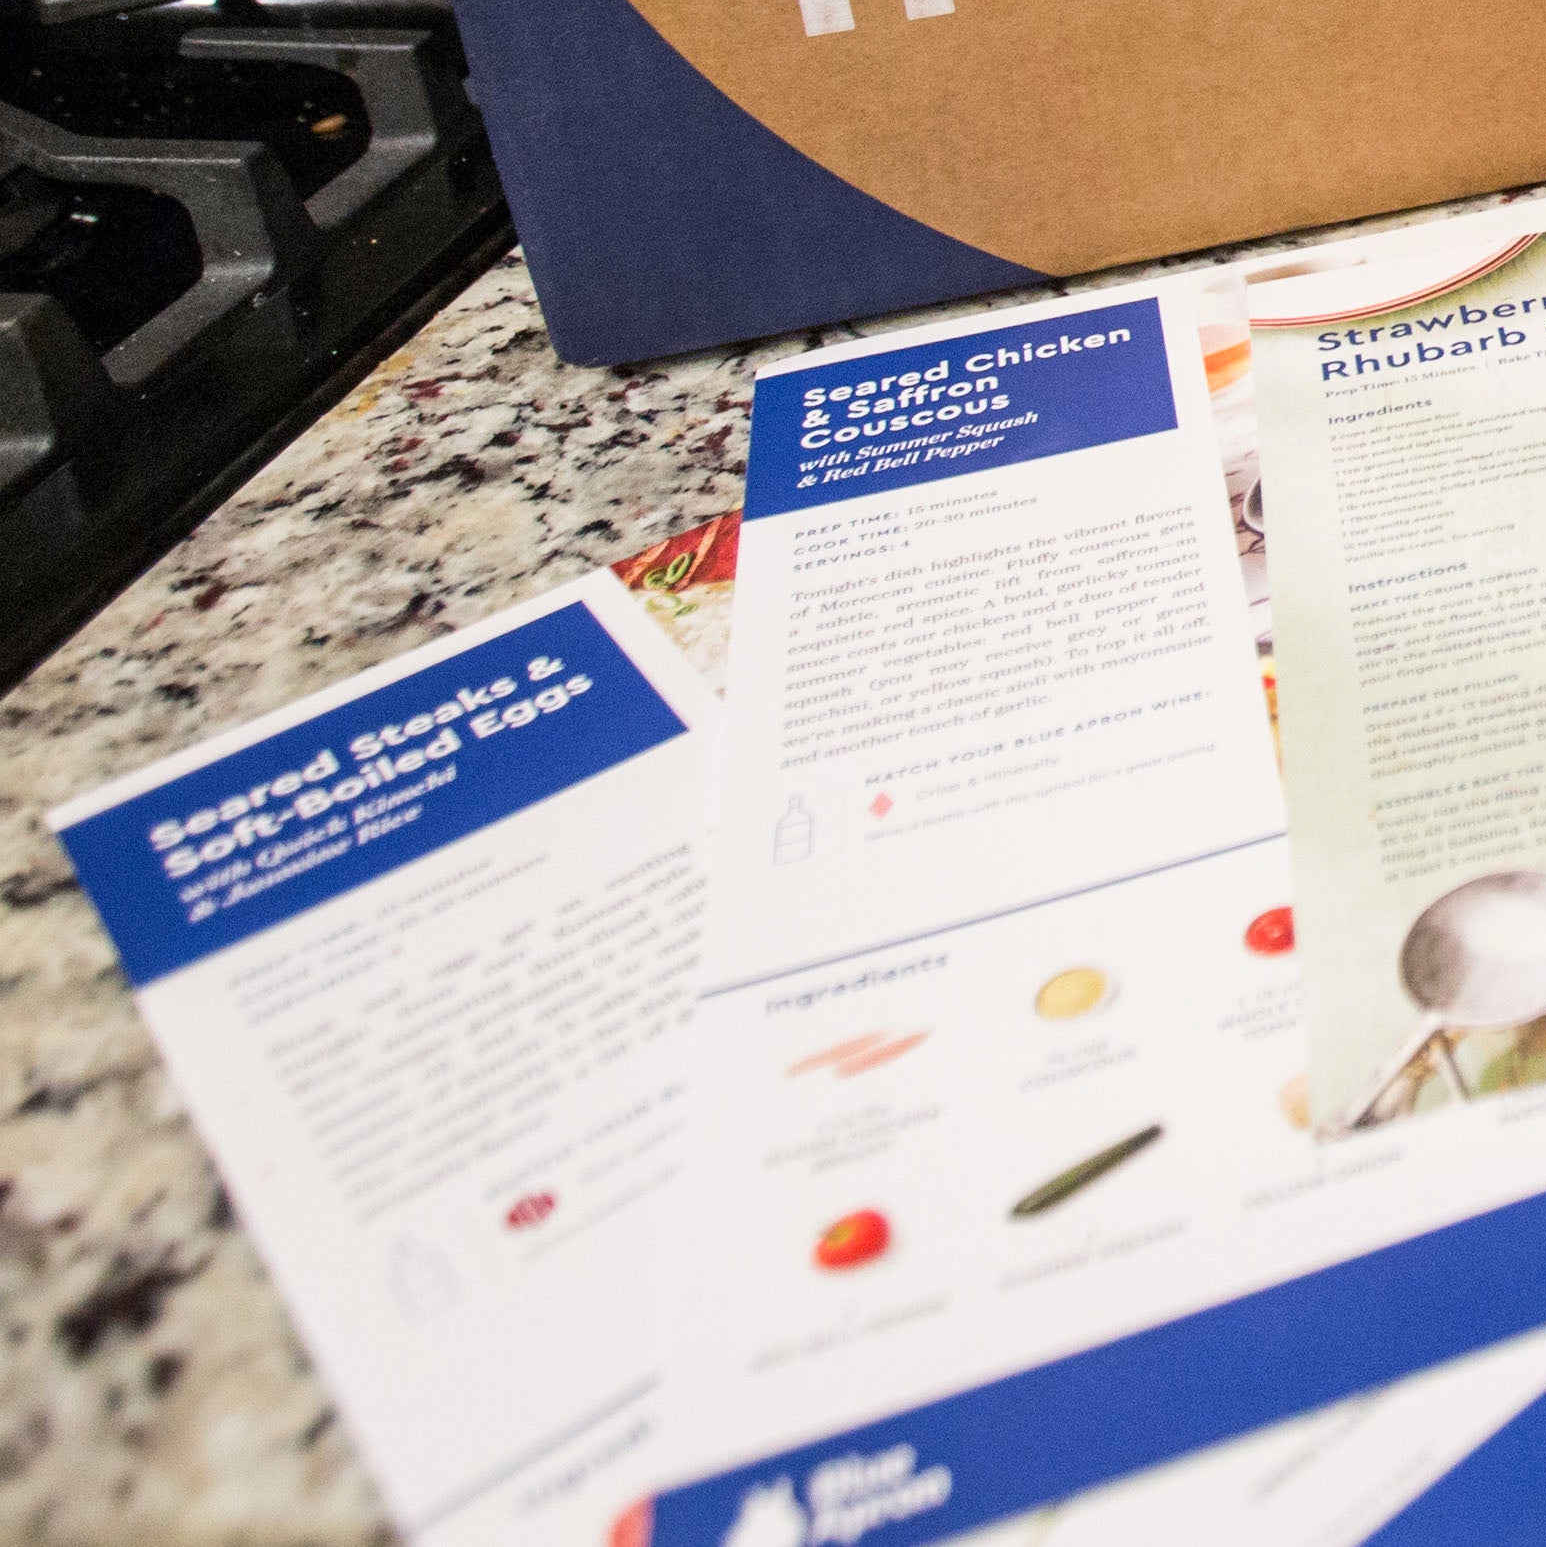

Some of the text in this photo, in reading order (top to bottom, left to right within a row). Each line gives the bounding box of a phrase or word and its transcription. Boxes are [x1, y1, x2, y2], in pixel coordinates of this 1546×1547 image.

[803, 325, 1132, 408] Seared Chicken
[1321, 325, 1527, 382] Rhubarb
[800, 392, 1011, 449] Couscous
[801, 374, 999, 429] & Saffron
[1327, 398, 1433, 426] Ingredients
[796, 435, 1005, 488] & Red Bell Pepper
[799, 411, 1039, 472] with Summer Squash
[793, 537, 850, 556] COOK
[859, 524, 909, 542] TIME:
[969, 497, 1037, 518] minutes
[794, 490, 998, 540] PREP TIME: 15 minutes
[793, 540, 911, 573] SERVINGS: 4
[1348, 562, 1468, 594] Instructions
[149, 655, 565, 851] Seared Steaks &
[162, 674, 593, 879] Soft-Boiled Eggs
[179, 861, 251, 904] with
[765, 952, 948, 1017] Ingredients
